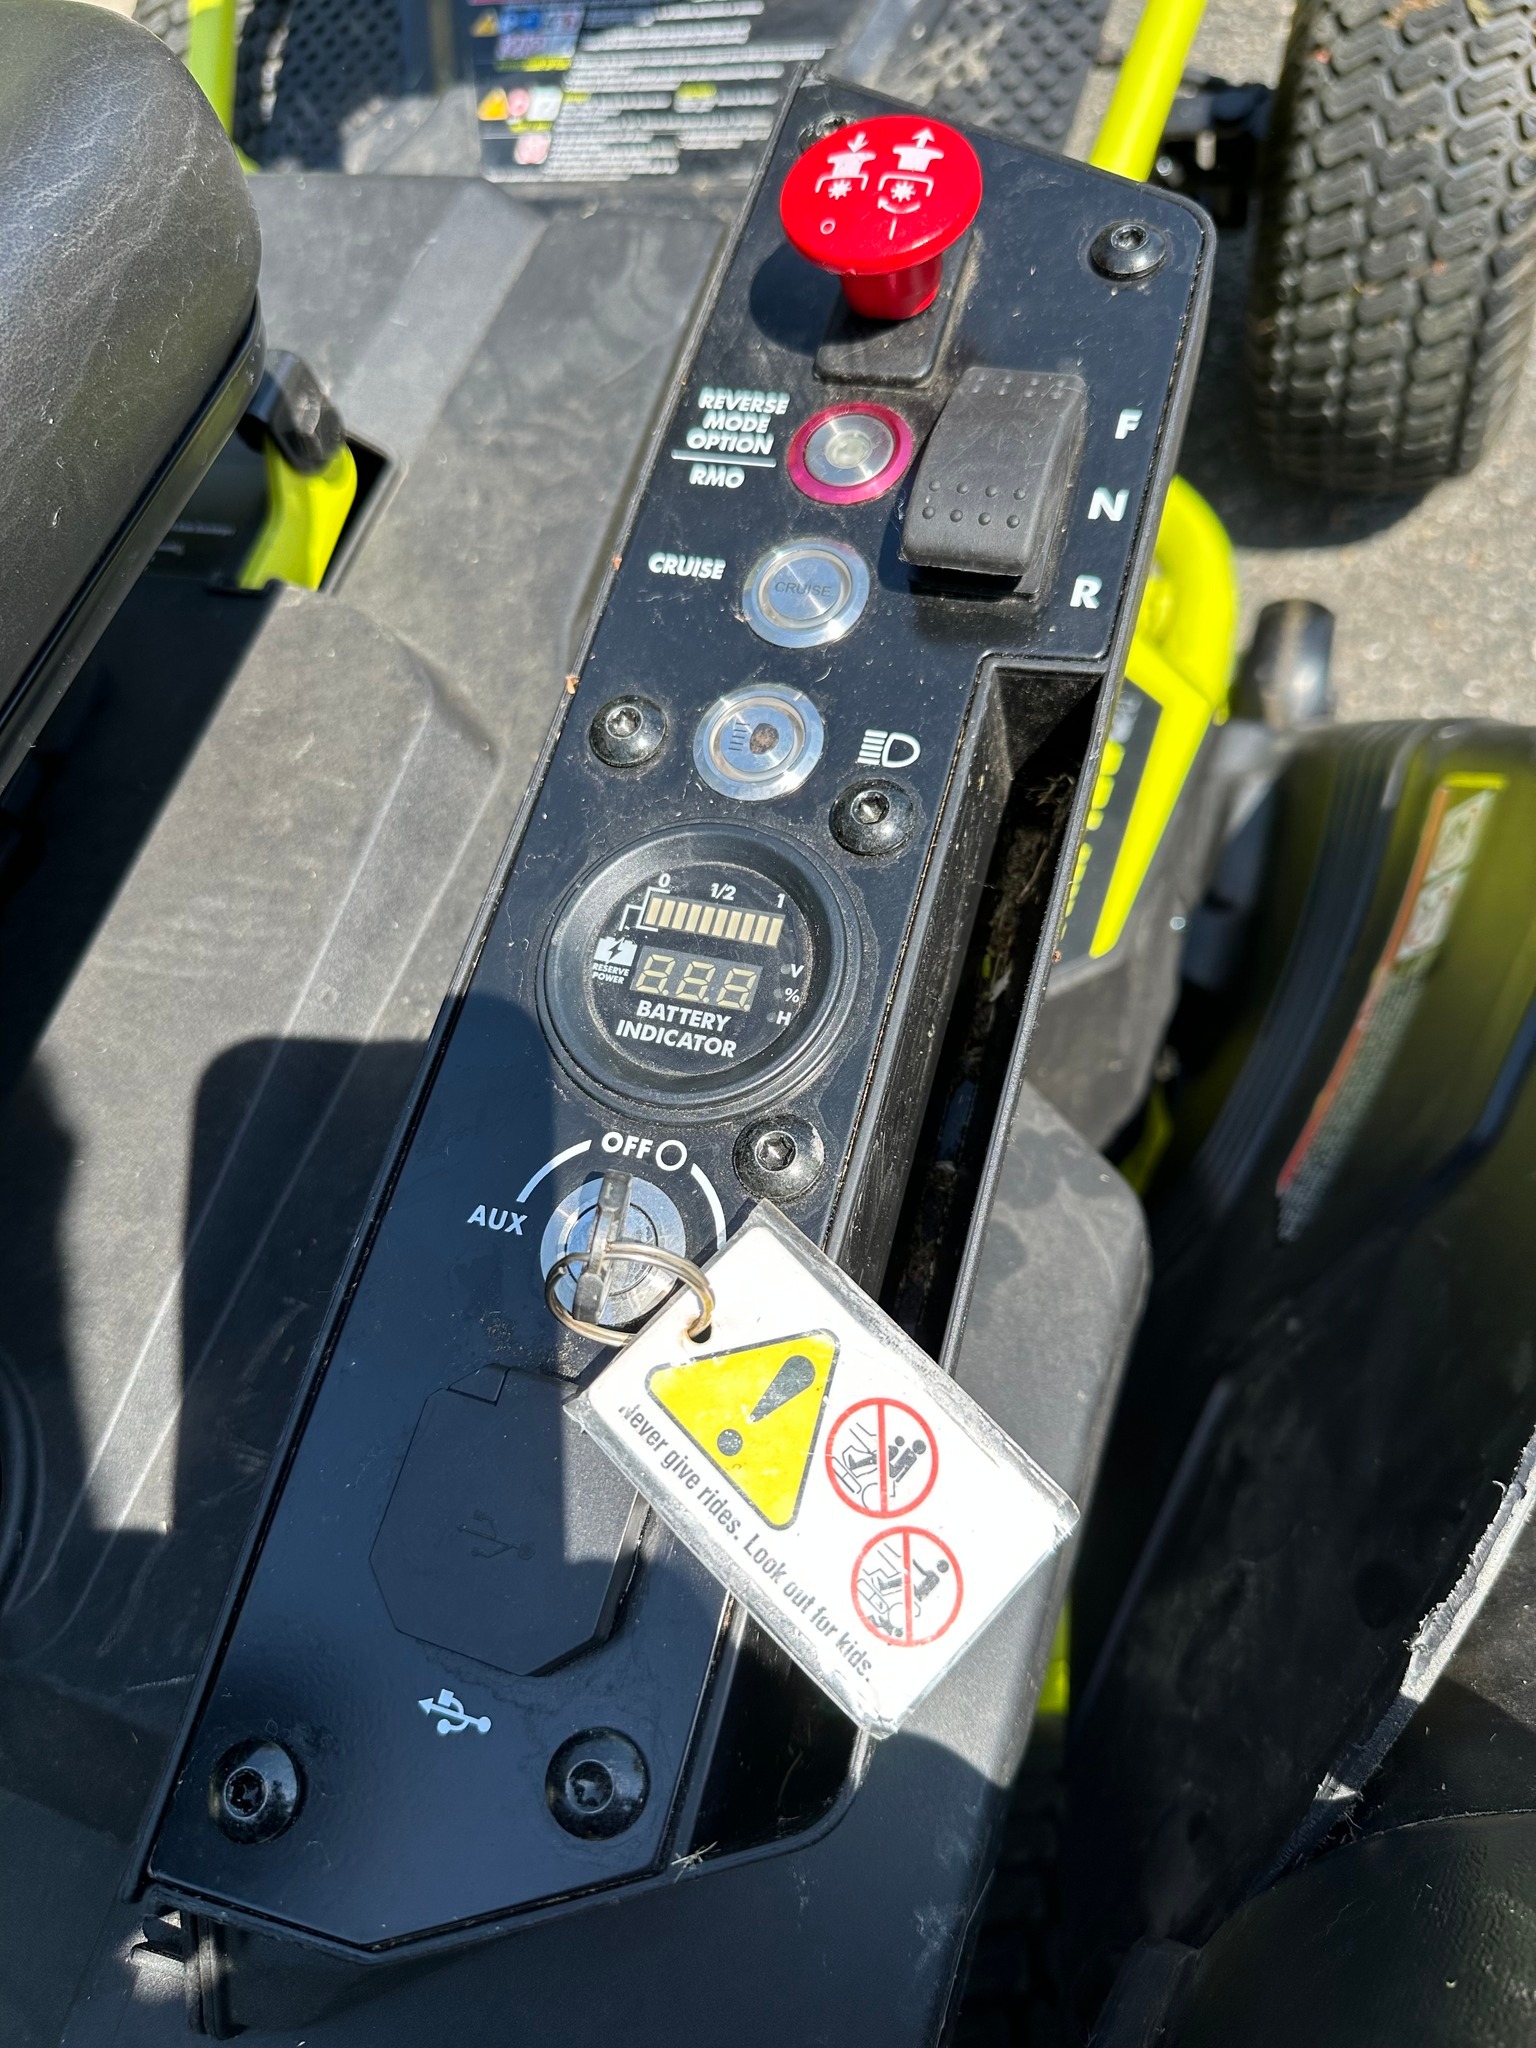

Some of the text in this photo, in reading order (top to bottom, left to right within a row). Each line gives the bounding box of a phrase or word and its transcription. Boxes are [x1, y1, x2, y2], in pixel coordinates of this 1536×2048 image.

[698, 387, 791, 415] REVERSE
[703, 411, 772, 434] MODE
[1113, 409, 1144, 440] F
[686, 427, 775, 456] OPTION
[689, 465, 745, 489] RMO
[1087, 488, 1130, 522] N
[648, 553, 727, 581] CRUISE
[773, 580, 833, 599] CRUISE
[1069, 575, 1104, 610] R
[710, 882, 736, 901] 1/2
[776, 893, 786, 909] 1
[592, 963, 630, 977] RESERVE
[592, 971, 625, 985] POWER
[790, 963, 804, 978] V
[784, 987, 800, 1003] %
[636, 1000, 732, 1033] BATTERY
[776, 1011, 791, 1026] H
[615, 1019, 738, 1059] INDICATOR
[601, 1131, 653, 1160] OFF
[466, 1204, 528, 1236] AUX
[660, 1450, 701, 1490] give
[697, 1487, 742, 1540] rides.
[743, 1533, 788, 1584] Look
[783, 1581, 816, 1614] out
[809, 1606, 839, 1637] for
[835, 1631, 873, 1683] kids.
